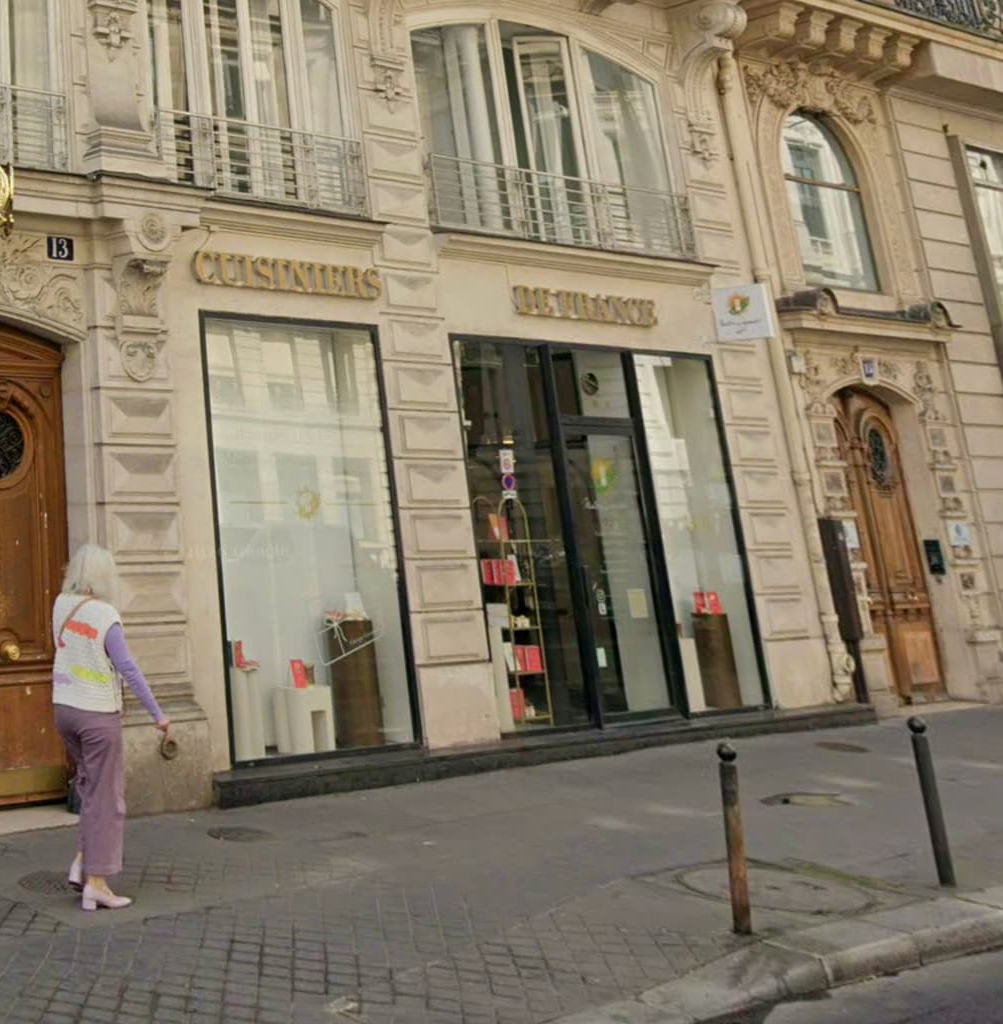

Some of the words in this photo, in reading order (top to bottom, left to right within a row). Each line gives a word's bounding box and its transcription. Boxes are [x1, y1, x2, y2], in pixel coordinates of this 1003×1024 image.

[51, 237, 69, 258] 13
[193, 251, 382, 300] CUISINIERS
[513, 285, 554, 320] DE
[555, 289, 658, 328] FRANCE
